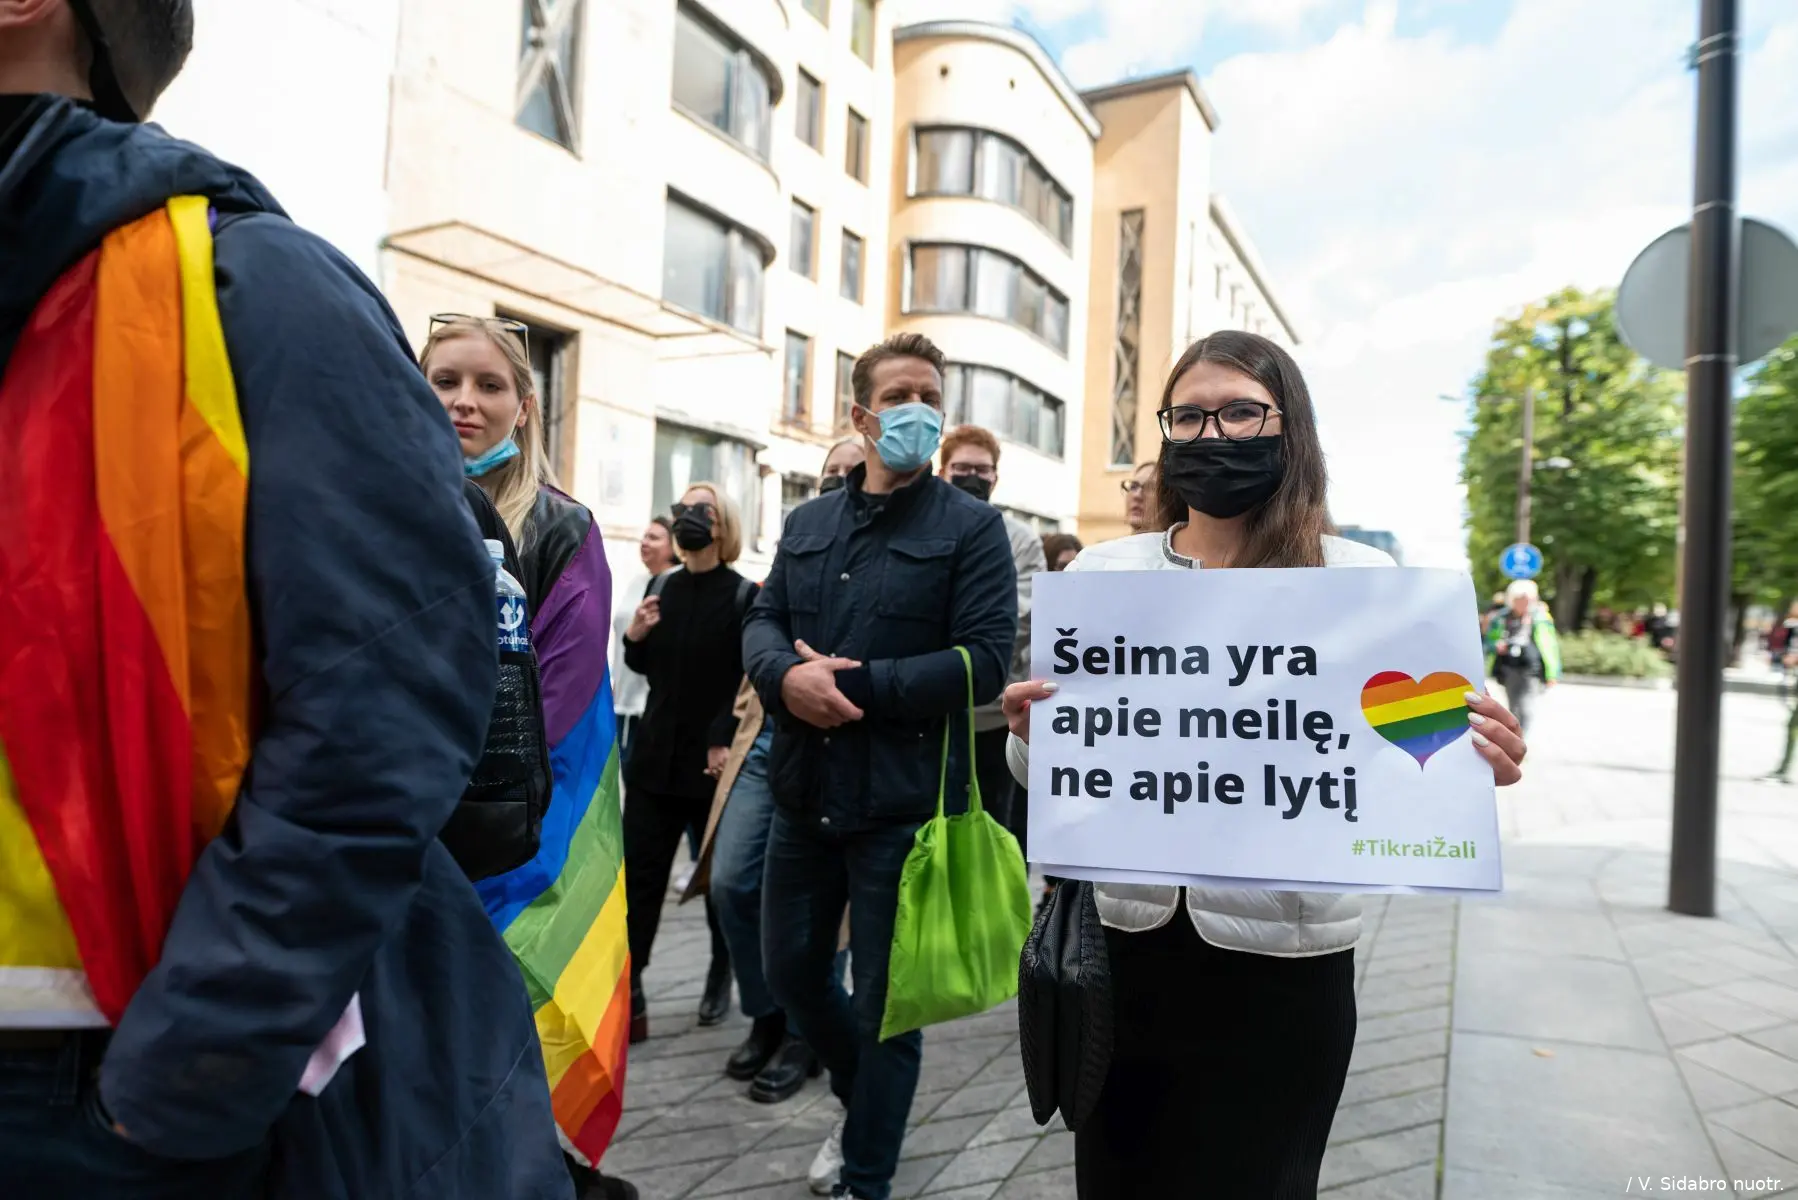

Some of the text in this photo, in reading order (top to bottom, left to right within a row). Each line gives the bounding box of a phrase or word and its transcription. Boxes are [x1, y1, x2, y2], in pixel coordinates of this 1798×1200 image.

[1053, 627, 1318, 687] Šeima yra
[1052, 698, 1351, 754] apie meilę,
[1051, 761, 1358, 822] ne apie lytį
[1352, 836, 1476, 859] #TikraiŽali
